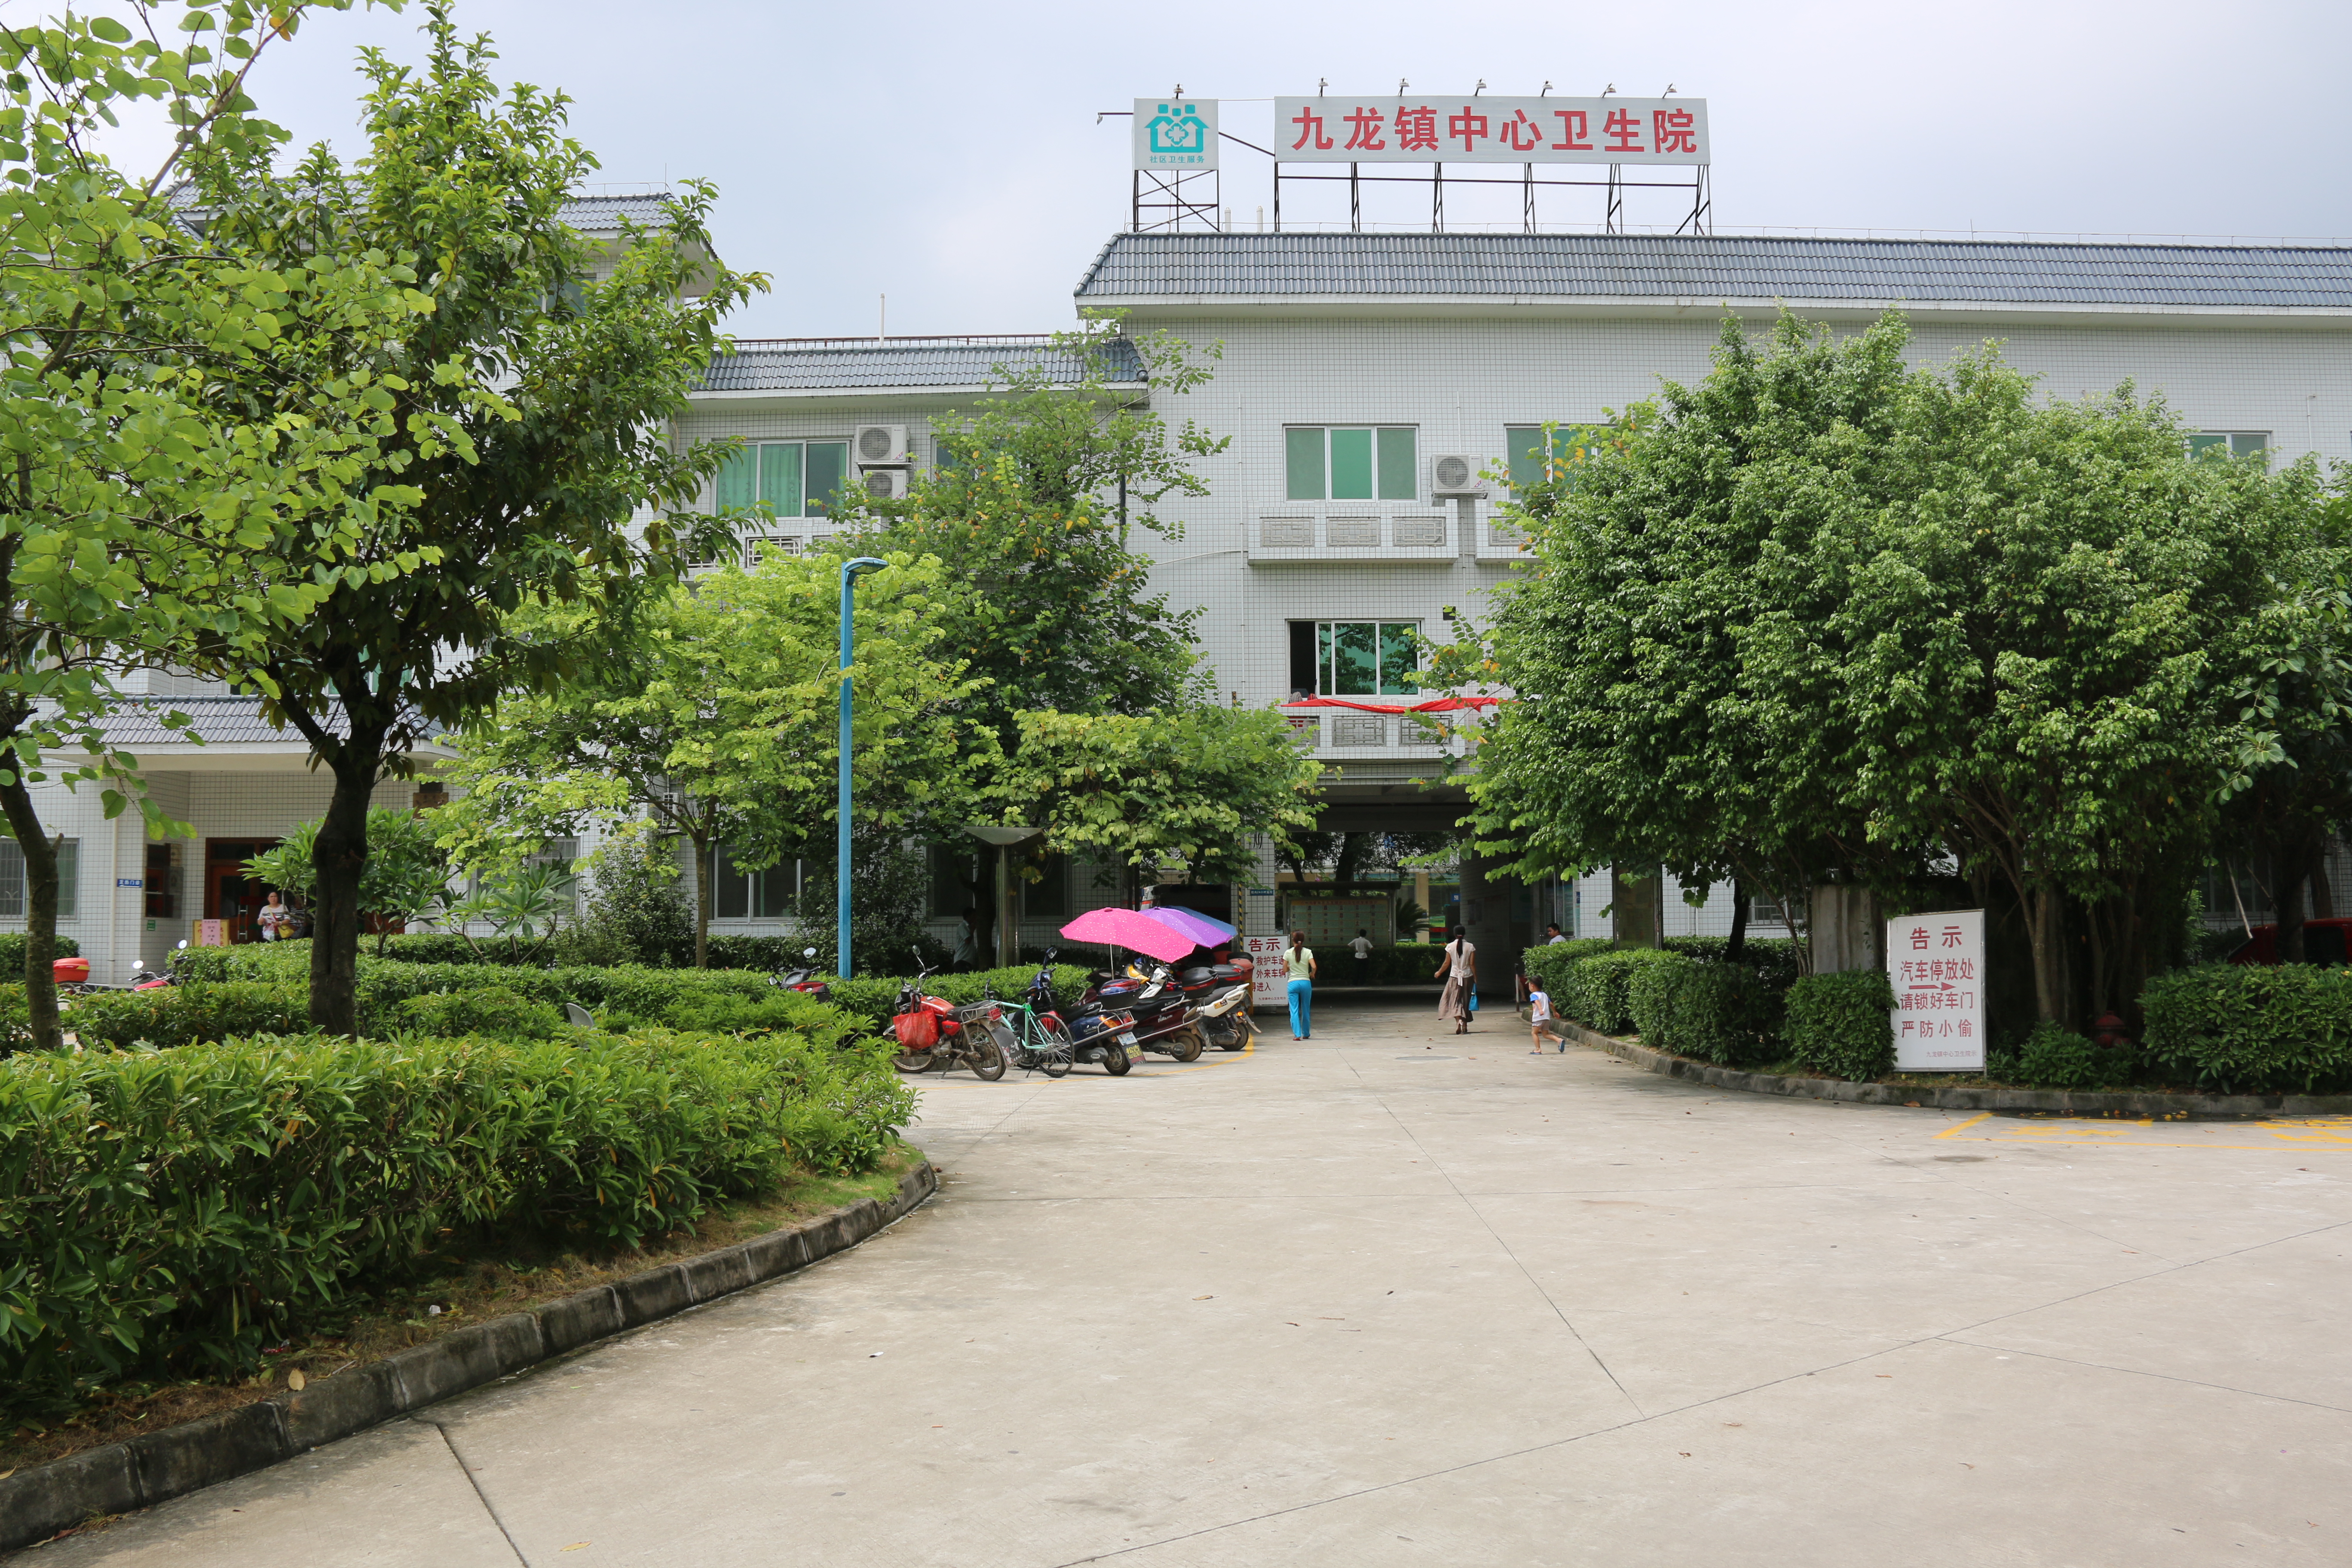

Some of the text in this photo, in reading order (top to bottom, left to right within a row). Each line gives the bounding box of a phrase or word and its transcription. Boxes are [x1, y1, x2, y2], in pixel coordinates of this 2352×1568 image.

[1292, 106, 1697, 153] 九龙镇中心卫生院
[1150, 155, 1205, 163] 社区卫生服务
[1248, 938, 1280, 952] 告示
[1910, 926, 1963, 950] 告示
[1900, 958, 1974, 981] 汽车停放处
[1900, 992, 1973, 1011] 请锁好车门
[1902, 1019, 1972, 1038] 严防小偷
